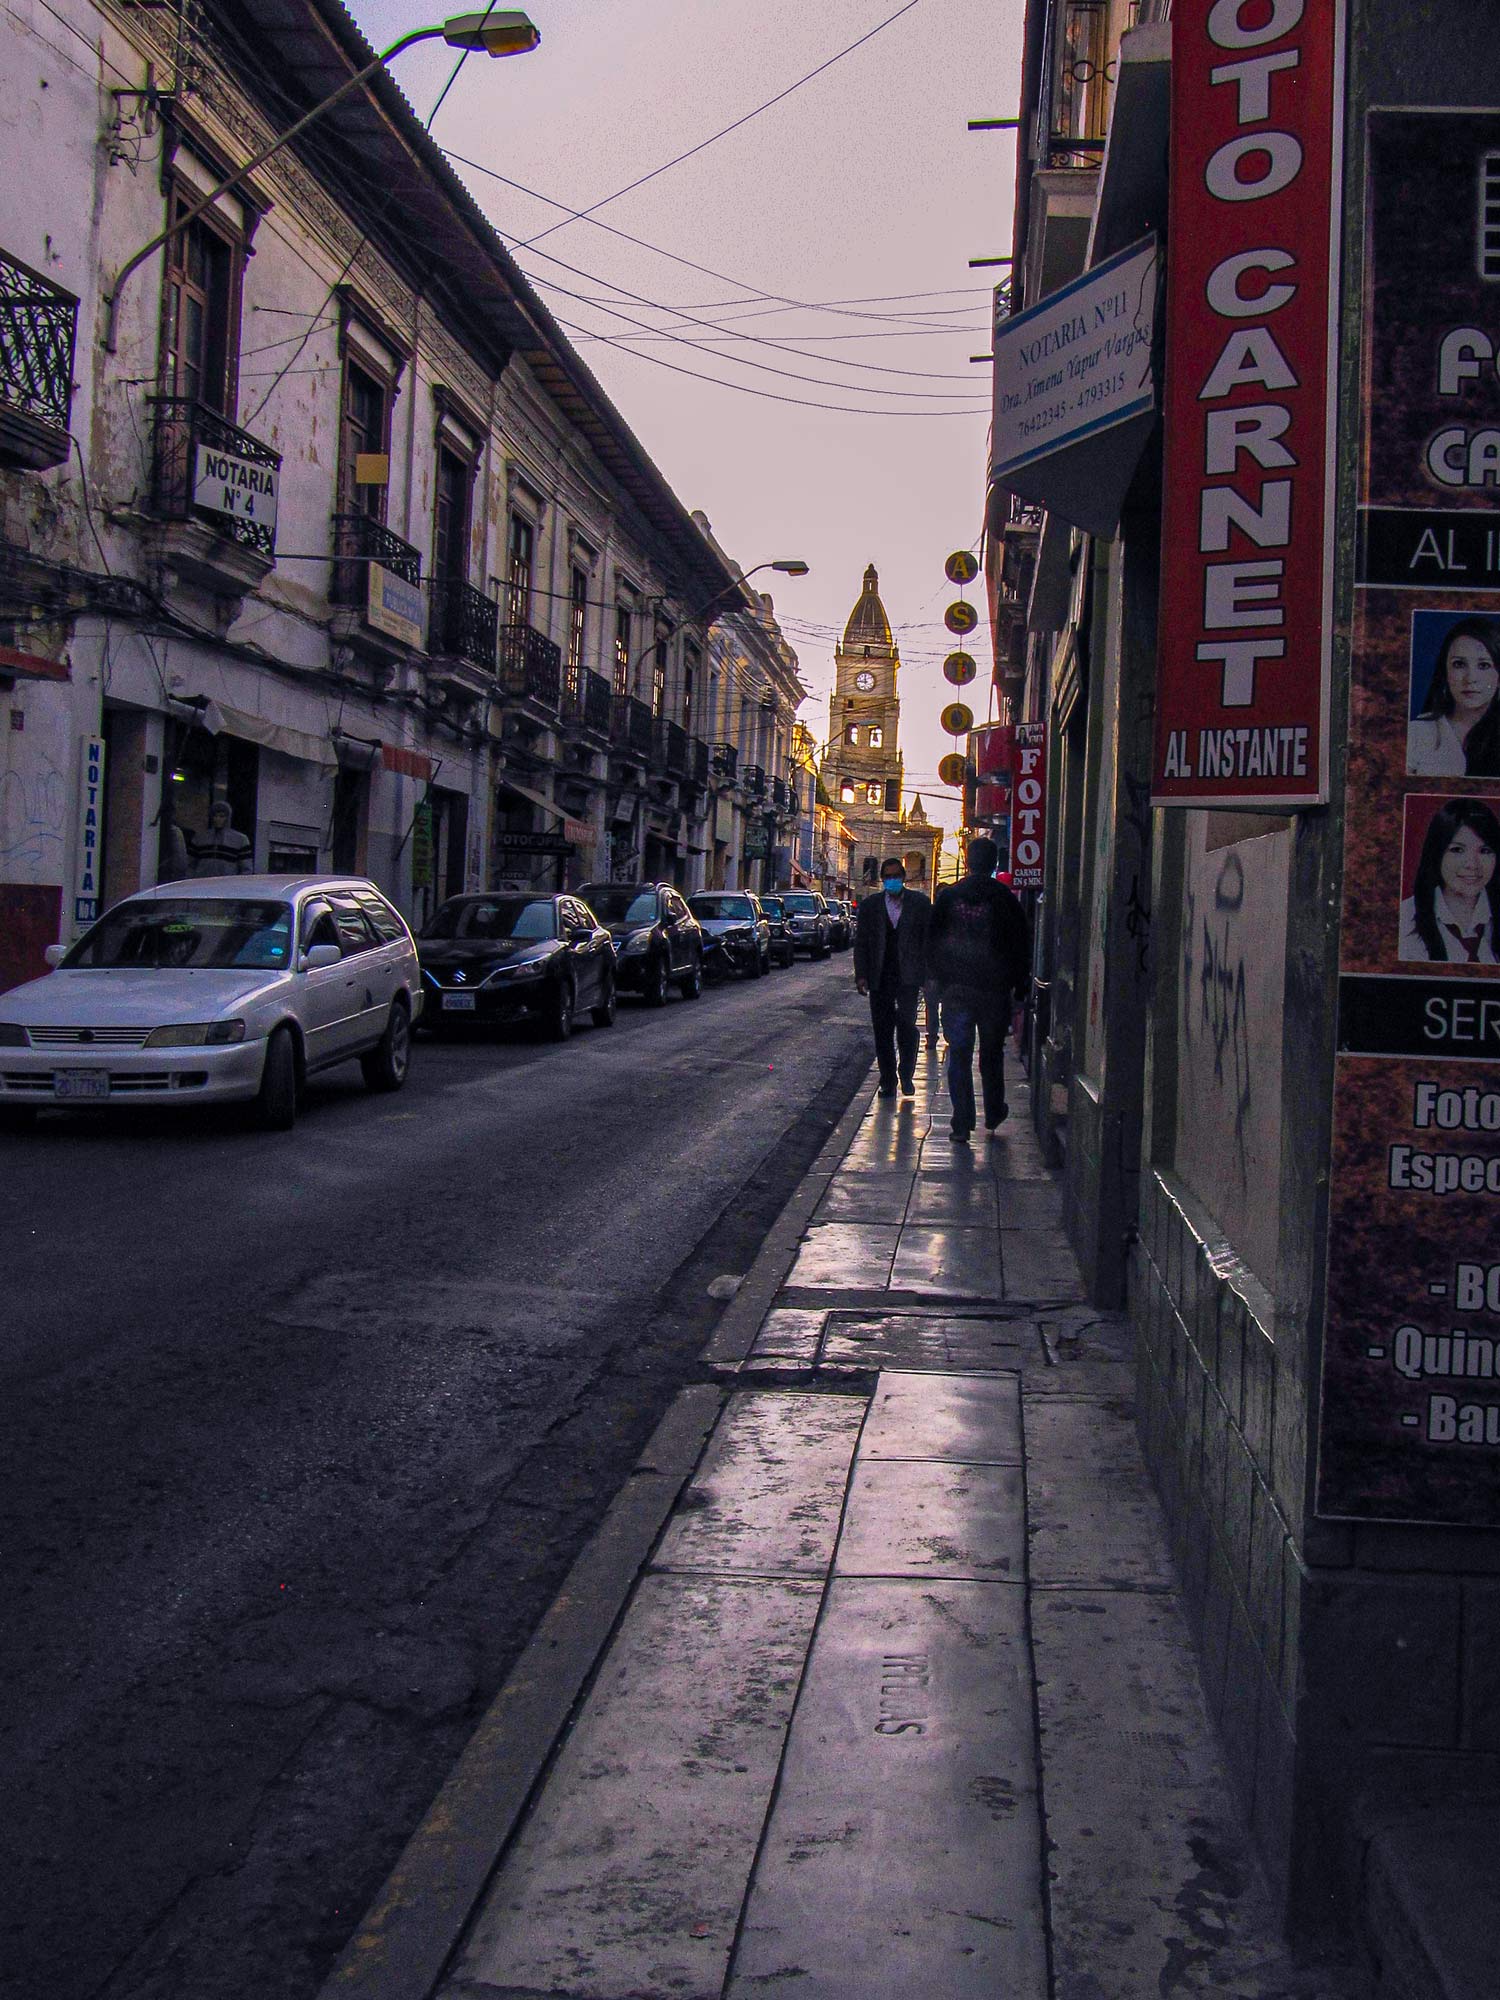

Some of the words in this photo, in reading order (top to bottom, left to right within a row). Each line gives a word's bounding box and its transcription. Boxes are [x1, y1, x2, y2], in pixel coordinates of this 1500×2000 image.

[1001, 393, 1023, 415] Dra.
[1025, 370, 1063, 401] Ximena
[1066, 349, 1101, 384] Yapur
[1104, 324, 1150, 359] Vargas
[1018, 316, 1087, 371] NOTARIA
[206, 453, 275, 497] NOTARIA
[1196, 248, 1299, 706] CARNET
[245, 494, 254, 516] 4
[1409, 528, 1467, 570] AL
[1163, 730, 1193, 779] AL
[1198, 727, 1308, 779] INSTANTE
[82, 743, 99, 891] NOTARIA
[1016, 748, 1042, 866] FOTO
[1013, 877, 1022, 886] EN
[1014, 868, 1042, 877] CARNET
[1416, 1083, 1500, 1129] Foto
[1395, 1326, 1500, 1379] Quin
